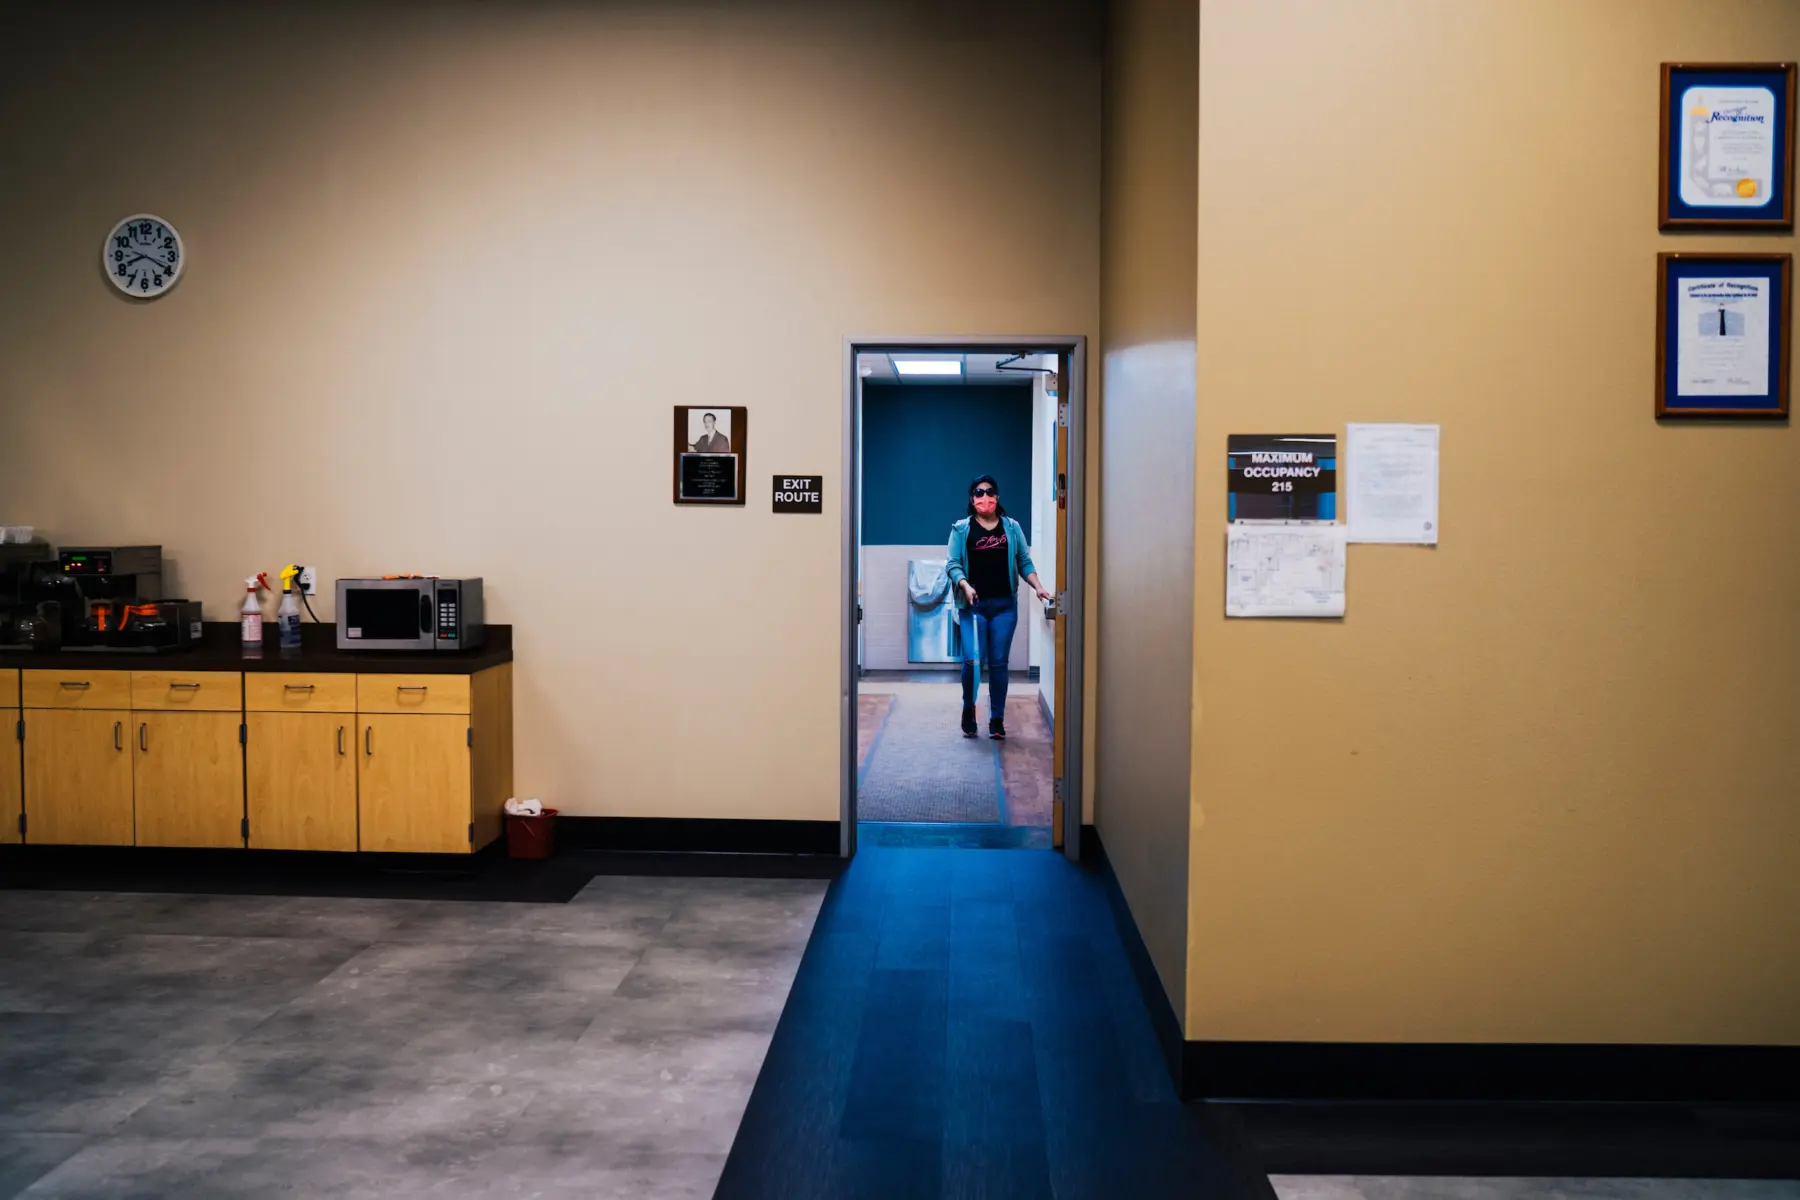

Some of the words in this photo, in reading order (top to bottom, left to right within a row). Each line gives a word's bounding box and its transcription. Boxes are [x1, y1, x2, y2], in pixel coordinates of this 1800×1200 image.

[1705, 111, 1765, 124] Recognition
[128, 226, 138, 238] 11
[139, 222, 152, 235] 12
[156, 226, 162, 239] 1
[115, 236, 129, 248] 10
[163, 237, 173, 249] 2
[115, 249, 124, 262] 9
[167, 250, 176, 263] 3
[118, 263, 127, 277] 8
[163, 265, 173, 277] 4
[127, 274, 137, 286] 7
[140, 278, 149, 290] 6
[153, 274, 162, 286] 5
[1251, 452, 1313, 464] MAXIMUM
[1243, 467, 1321, 478] OCCUPANCY
[783, 479, 811, 490] EXIT
[1271, 481, 1293, 493] 215
[775, 491, 819, 503] ROUTE
